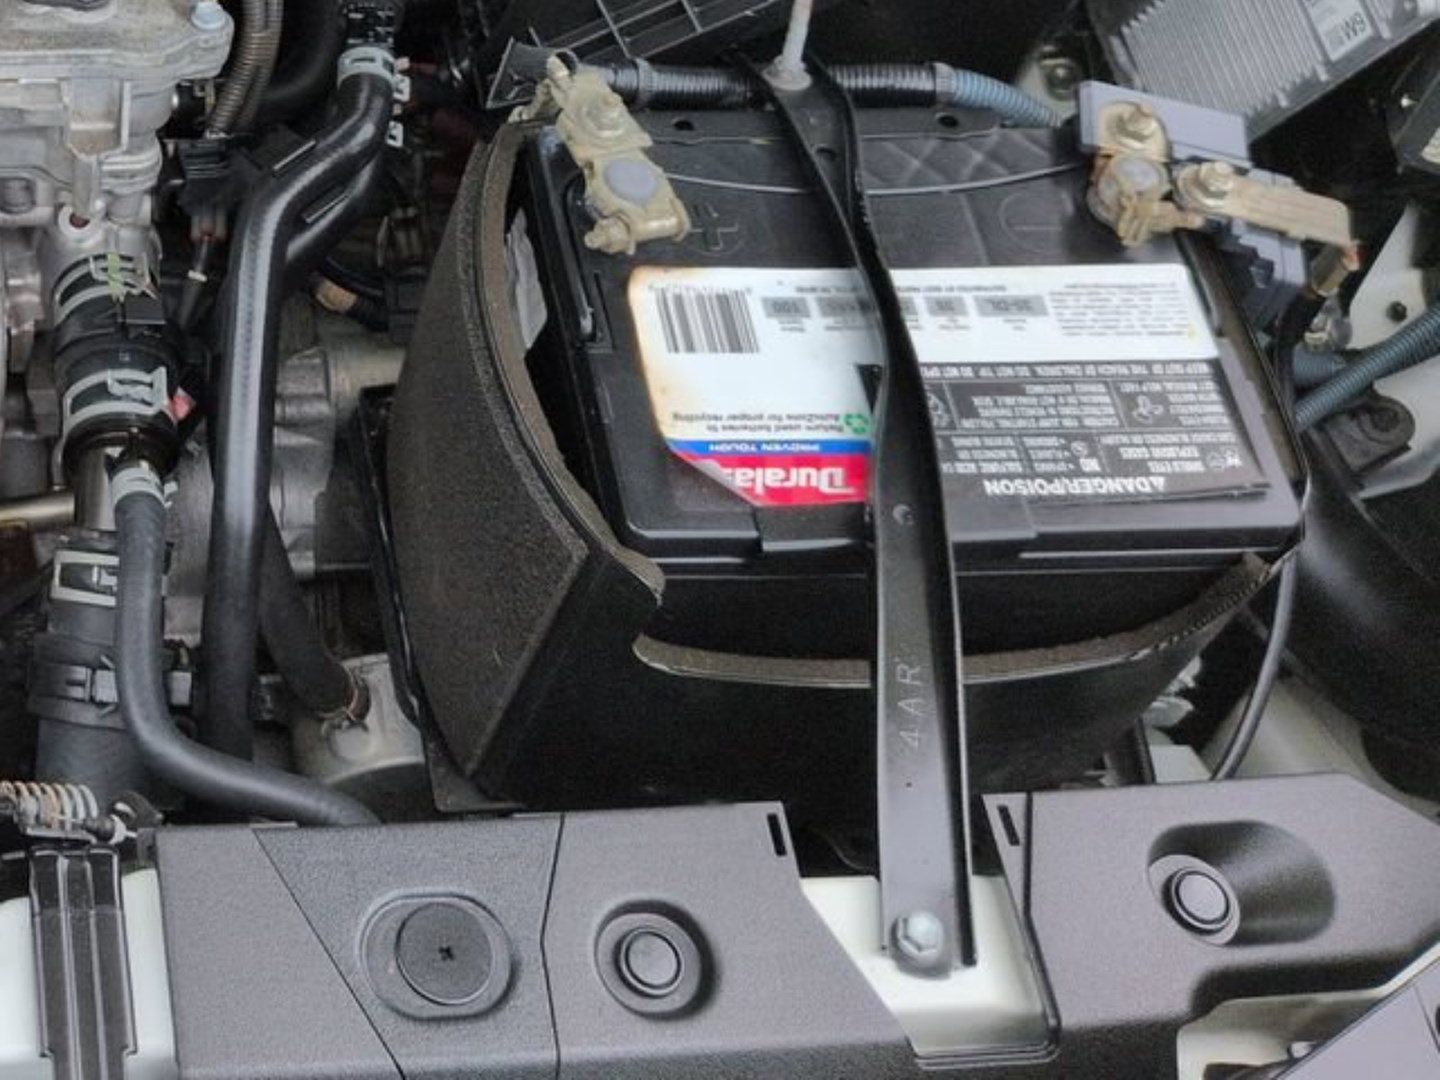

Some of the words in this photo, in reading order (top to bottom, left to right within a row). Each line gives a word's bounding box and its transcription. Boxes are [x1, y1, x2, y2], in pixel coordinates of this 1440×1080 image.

[709, 443, 758, 452] TOUGH
[761, 443, 821, 452] PROVEN
[984, 477, 1151, 497] DANGER/POISON
